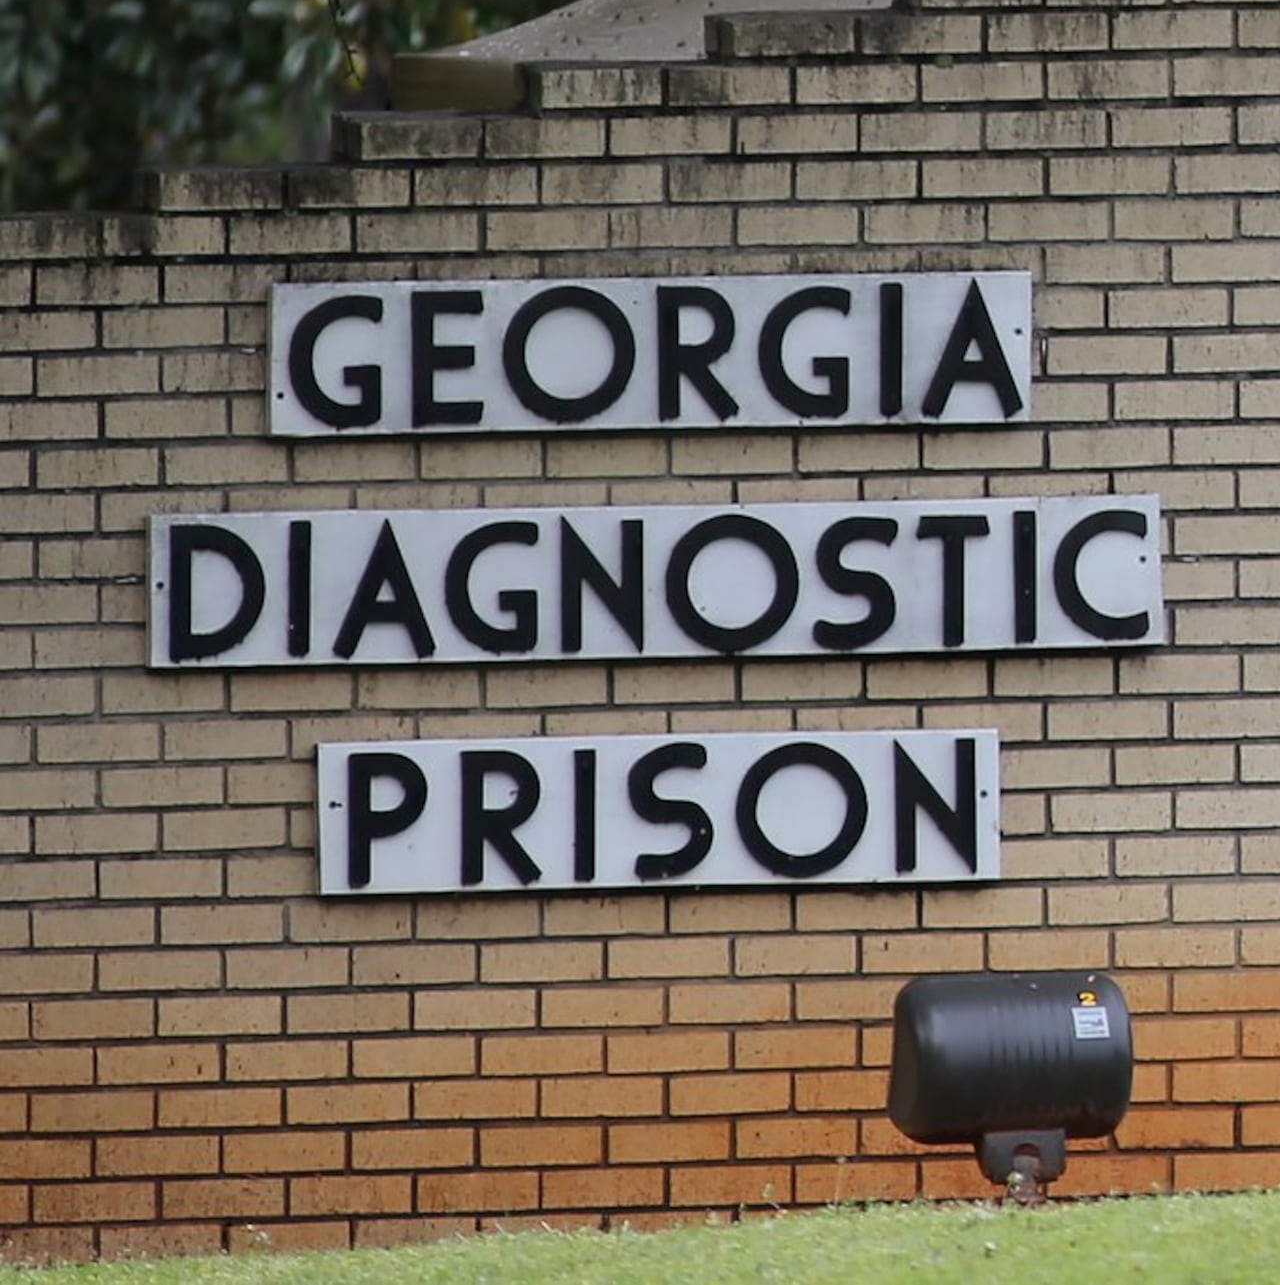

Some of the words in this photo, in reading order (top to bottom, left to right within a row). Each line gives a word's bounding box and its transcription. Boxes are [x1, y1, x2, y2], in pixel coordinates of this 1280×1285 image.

[286, 276, 1025, 429] GEORGIA
[167, 509, 1152, 663] DIAGNOSTIC
[346, 738, 978, 889] PRISON
